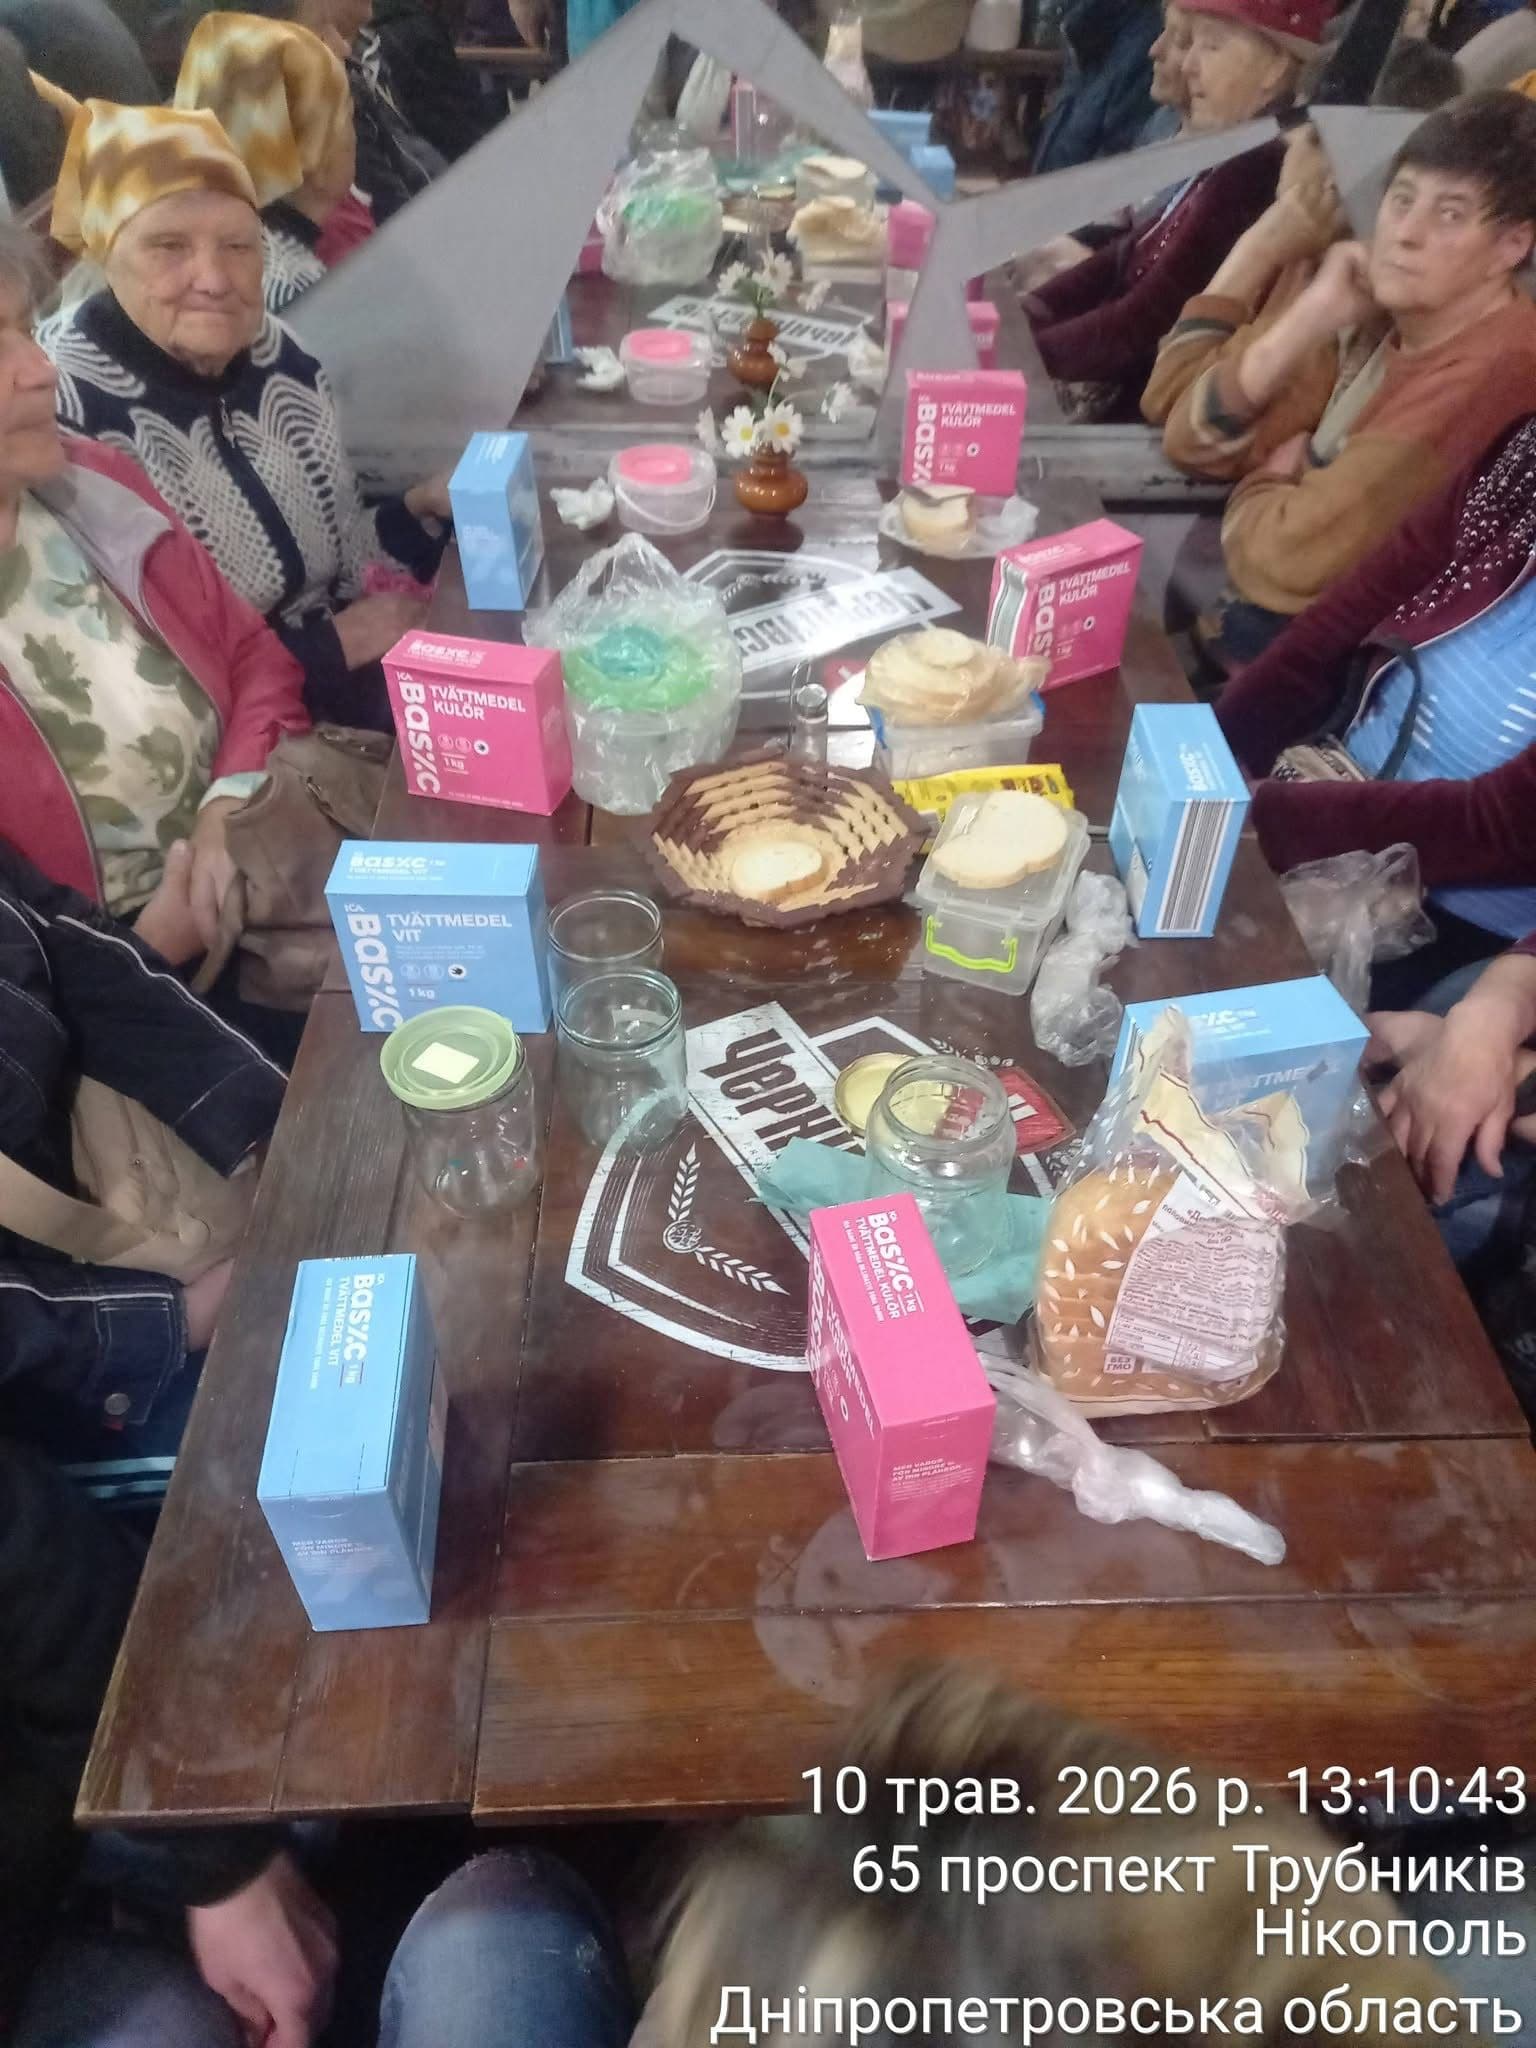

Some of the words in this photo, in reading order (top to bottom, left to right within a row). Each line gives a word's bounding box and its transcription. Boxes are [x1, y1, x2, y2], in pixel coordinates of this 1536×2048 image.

[429, 684, 526, 713] TVÄTTMEDEL
[433, 700, 485, 720] KULÖR
[386, 911, 513, 928] TVÄTTMEDEL
[392, 929, 422, 942] VIT
[417, 987, 435, 999] kg
[856, 1216, 885, 1282] TVÄTTMEDEL
[879, 1280, 901, 1320] KULÖR
[330, 1276, 351, 1347] TVÄTTMEDEL
[327, 1347, 341, 1367] VIT
[1110, 1356, 1131, 1364] БЕЗ
[1106, 1363, 1132, 1372] ГМО
